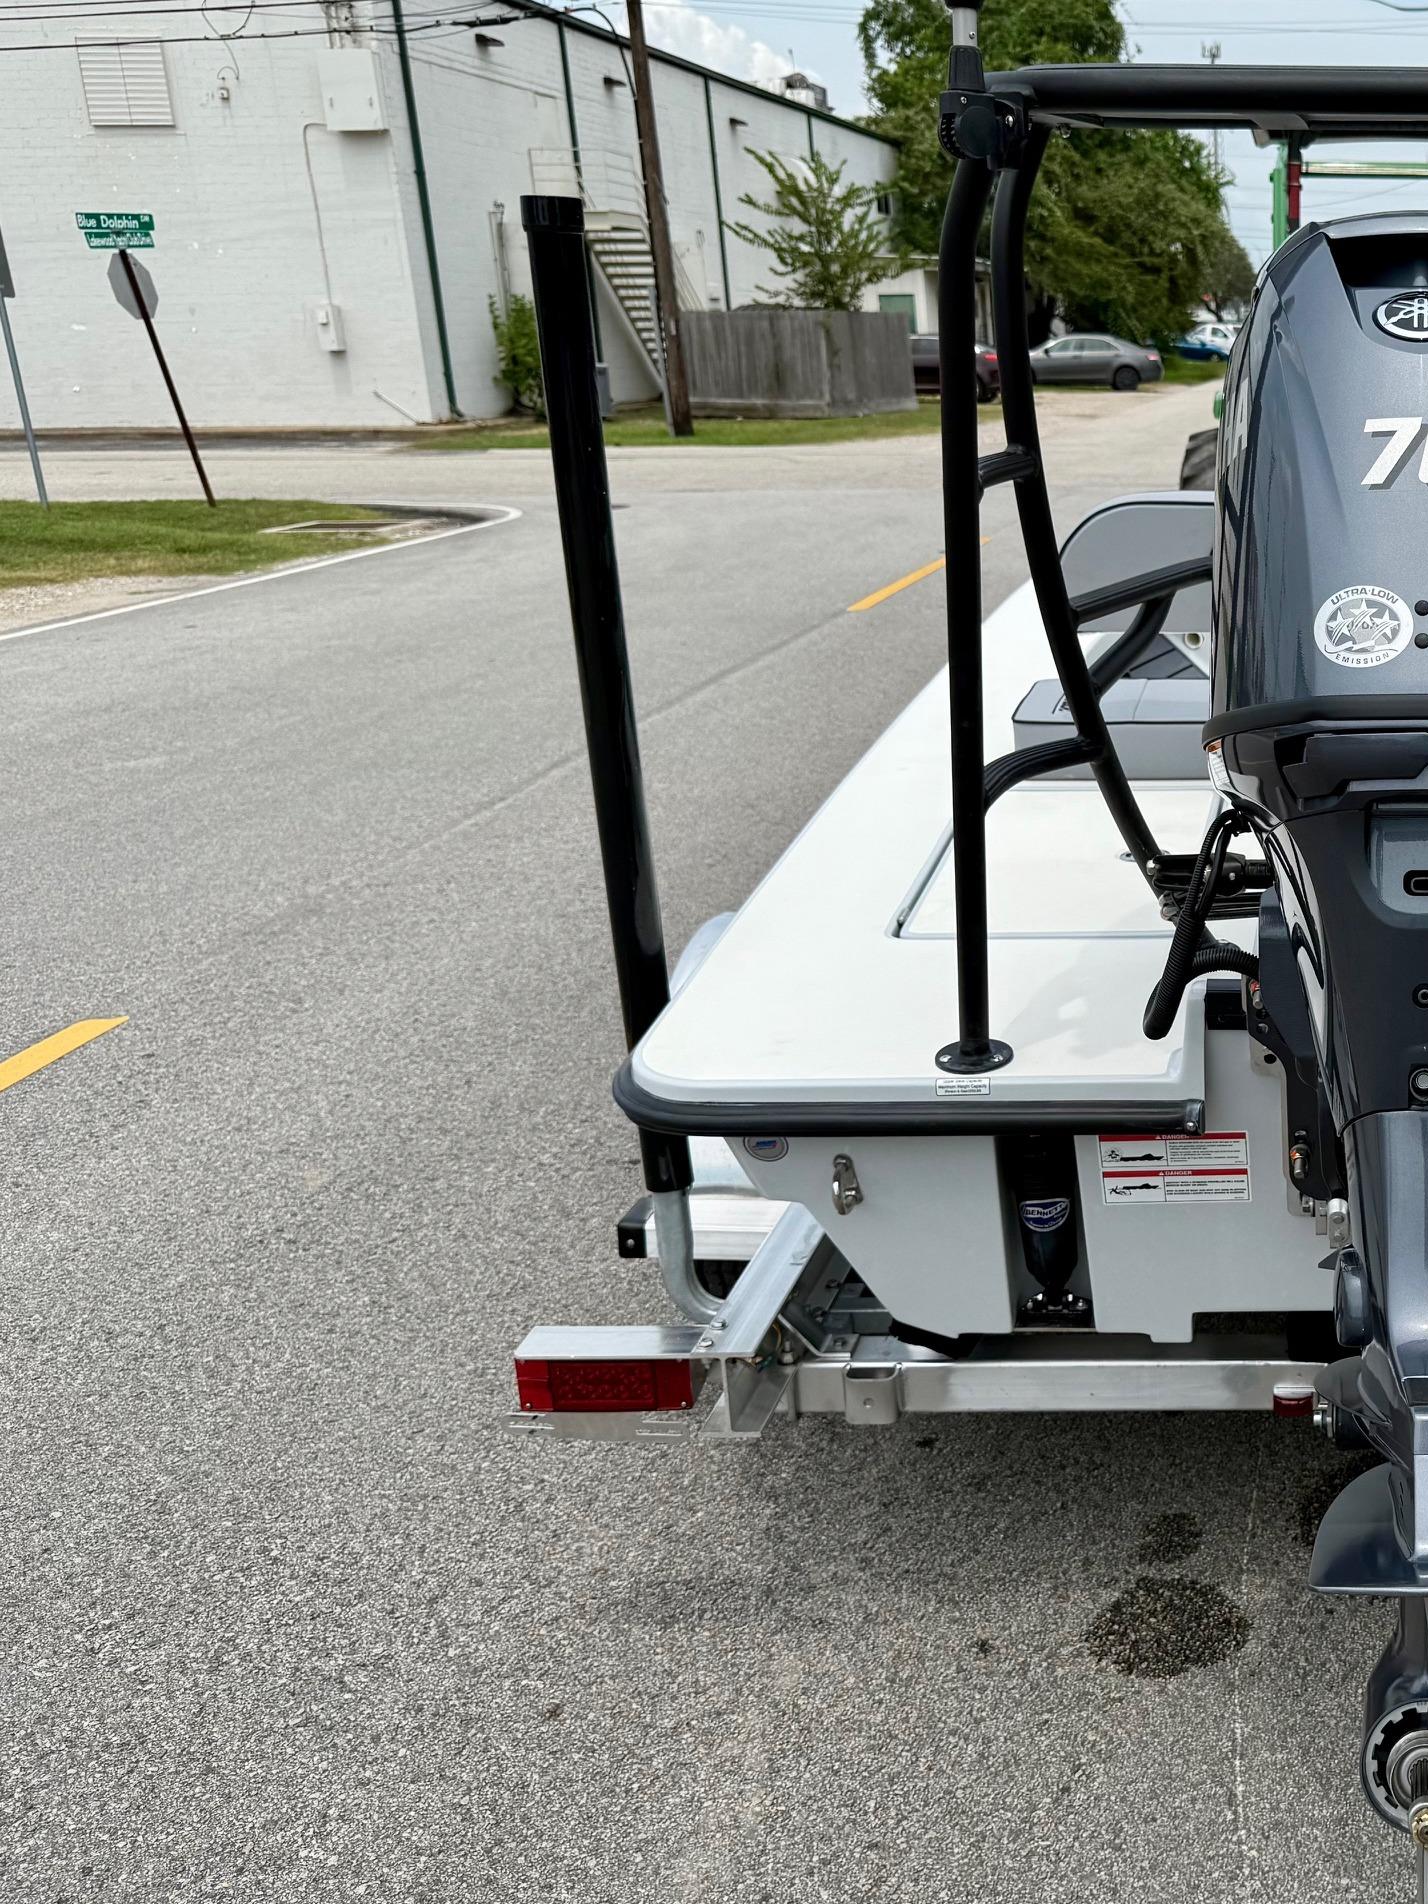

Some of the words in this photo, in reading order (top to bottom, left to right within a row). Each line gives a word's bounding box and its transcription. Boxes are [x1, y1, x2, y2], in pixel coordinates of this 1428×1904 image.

[77, 214, 97, 228] Blue
[100, 215, 139, 229] Dolphin
[1335, 651, 1390, 665] EMISSION
